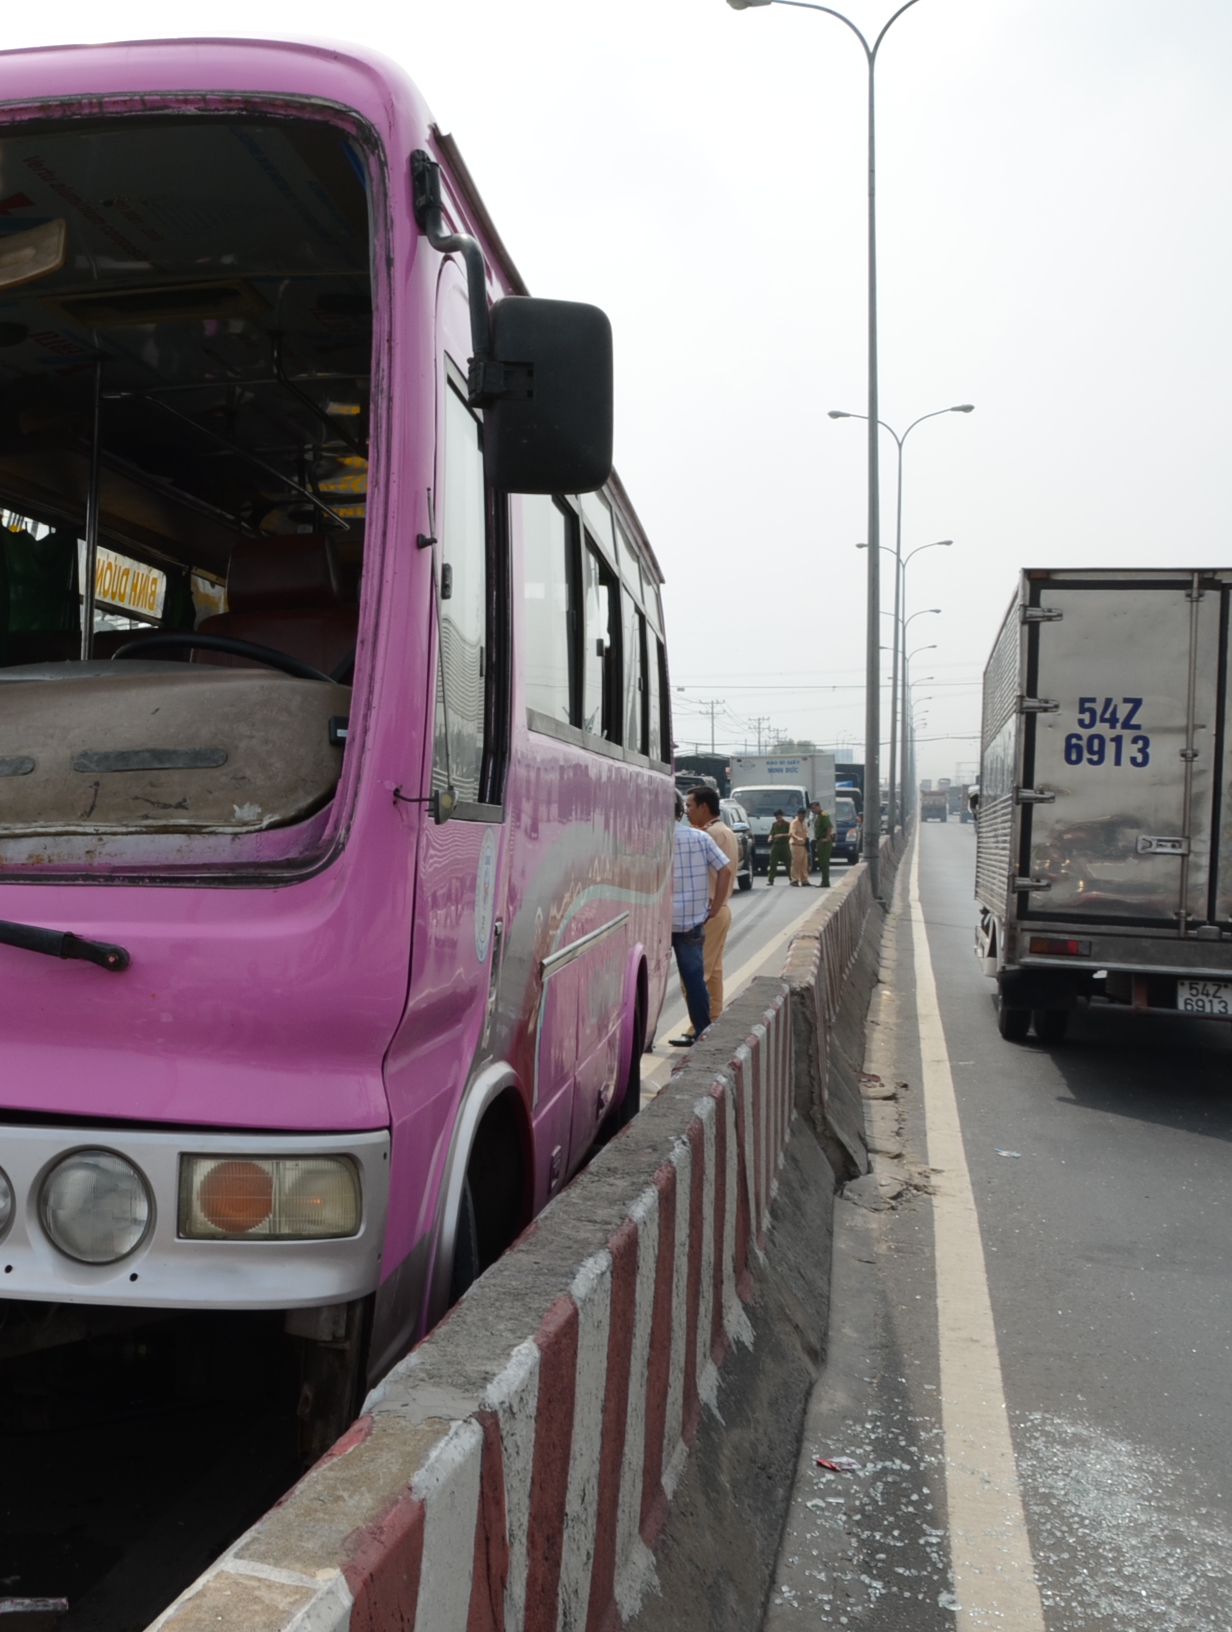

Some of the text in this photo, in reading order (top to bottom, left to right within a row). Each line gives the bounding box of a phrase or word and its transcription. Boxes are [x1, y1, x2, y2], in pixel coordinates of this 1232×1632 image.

[1076, 696, 1143, 731] 54Z
[1064, 733, 1150, 768] 6913
[1188, 981, 1223, 999] 54Z
[1183, 997, 1228, 1014] 6913
